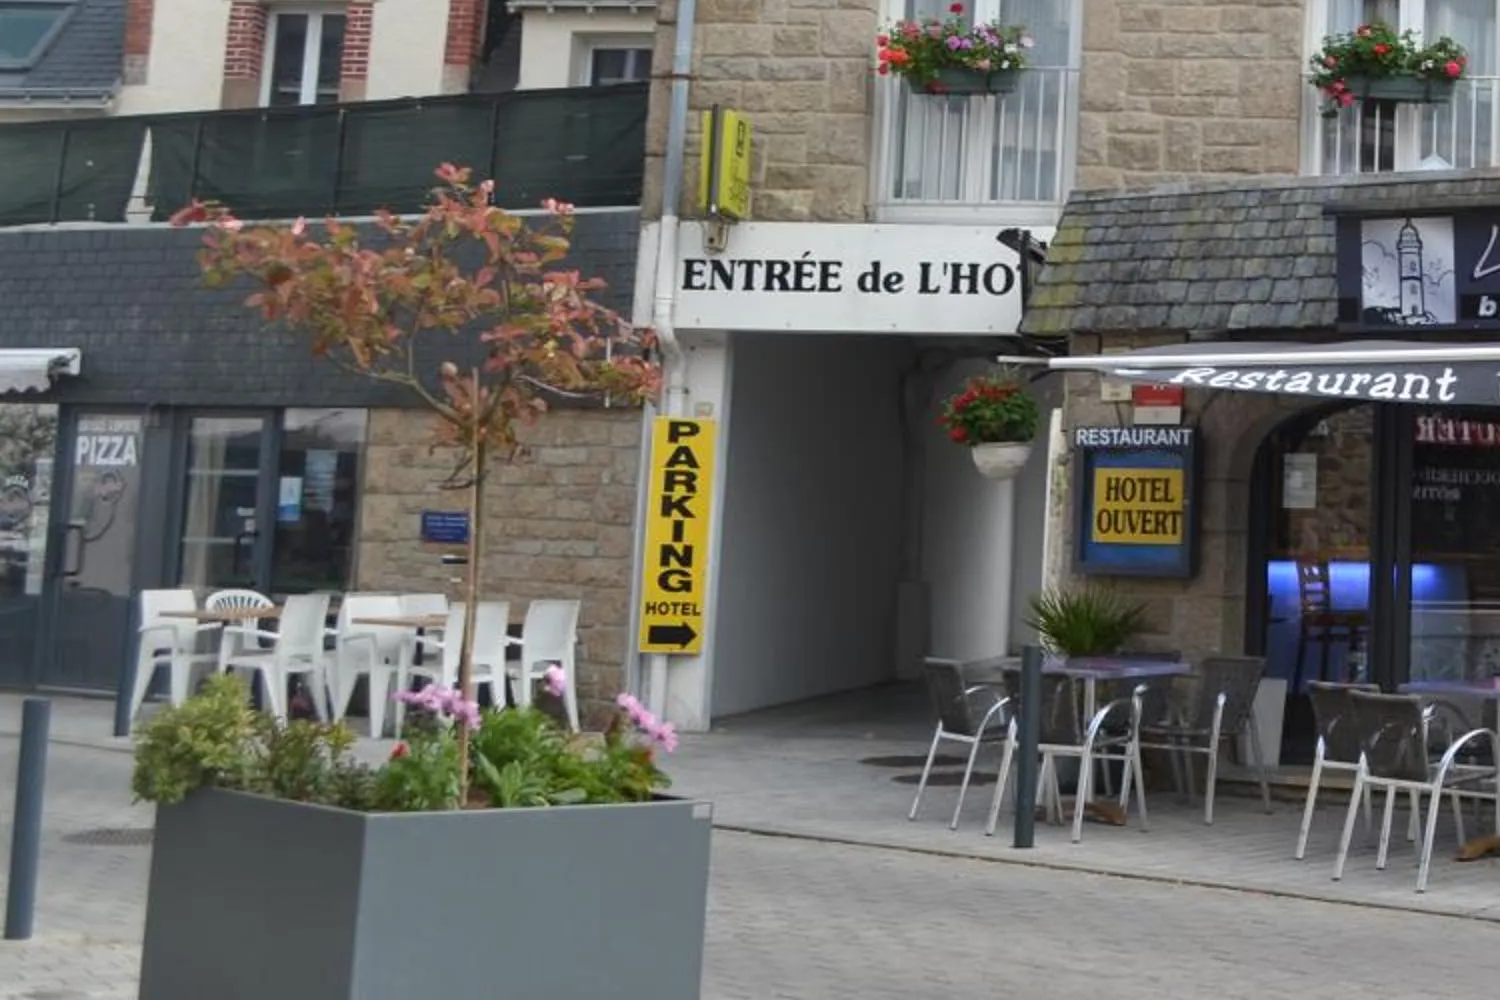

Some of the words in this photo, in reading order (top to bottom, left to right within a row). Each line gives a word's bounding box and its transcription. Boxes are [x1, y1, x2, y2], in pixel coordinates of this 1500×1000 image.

[682, 251, 842, 293] ENTRÉE
[857, 262, 904, 292] de
[918, 262, 1022, 296] L'HO
[1170, 364, 1459, 401] Restaurant
[75, 434, 137, 466] PIZZA
[1076, 428, 1192, 445] RESTAURANT
[1105, 477, 1175, 502] HOTEL
[657, 421, 700, 593] PARKING
[1097, 508, 1183, 535] OUVERT
[645, 601, 701, 616] HOTEL
